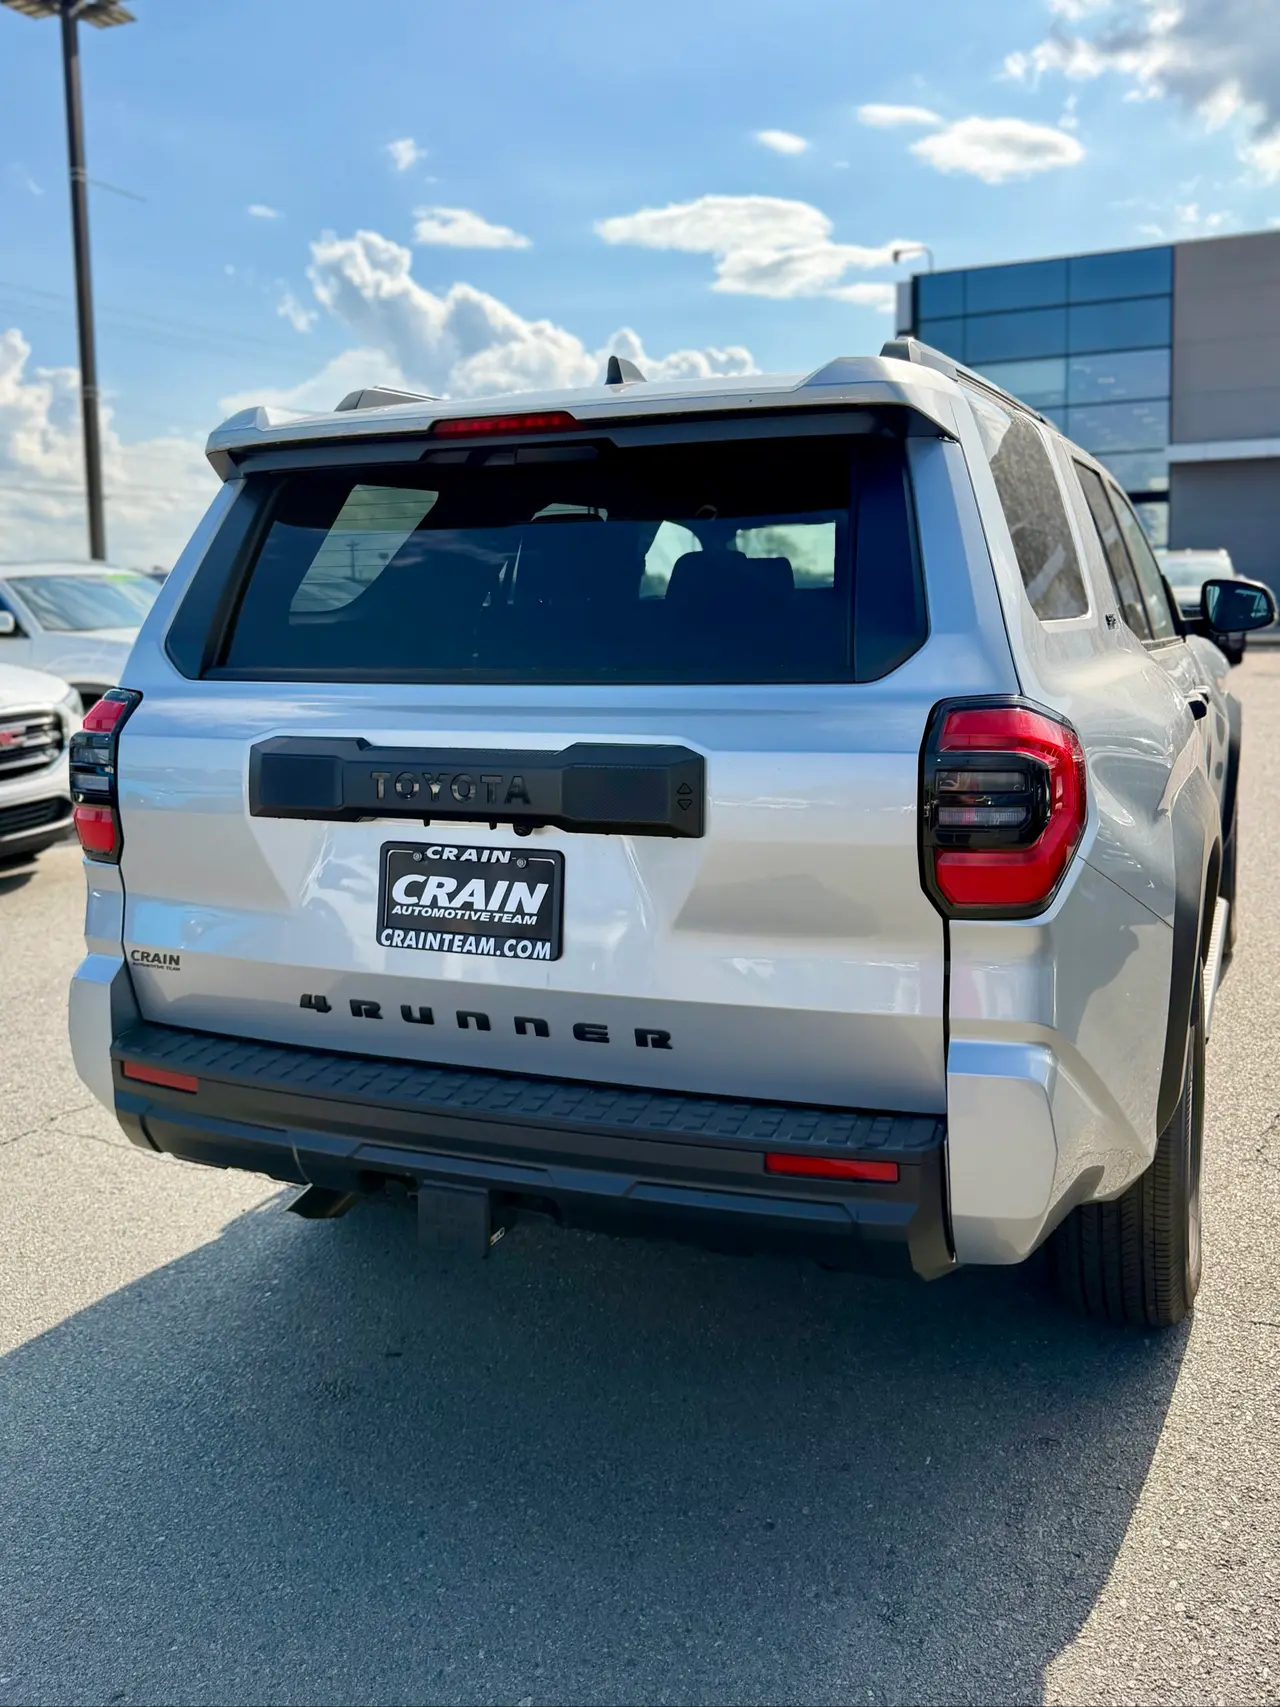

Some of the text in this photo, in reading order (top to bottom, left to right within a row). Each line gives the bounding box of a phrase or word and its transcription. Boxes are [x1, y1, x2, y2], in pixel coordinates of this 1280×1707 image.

[370, 771, 531, 805] TOYOTA
[426, 846, 512, 864] CRAIN
[391, 874, 549, 914] CRAIN
[391, 905, 537, 925] AUTOMOTIVE TEAM
[130, 949, 181, 966] CRAIN
[380, 928, 551, 960] CRAINTEAM.COM
[300, 993, 674, 1050] 4RUNNER
